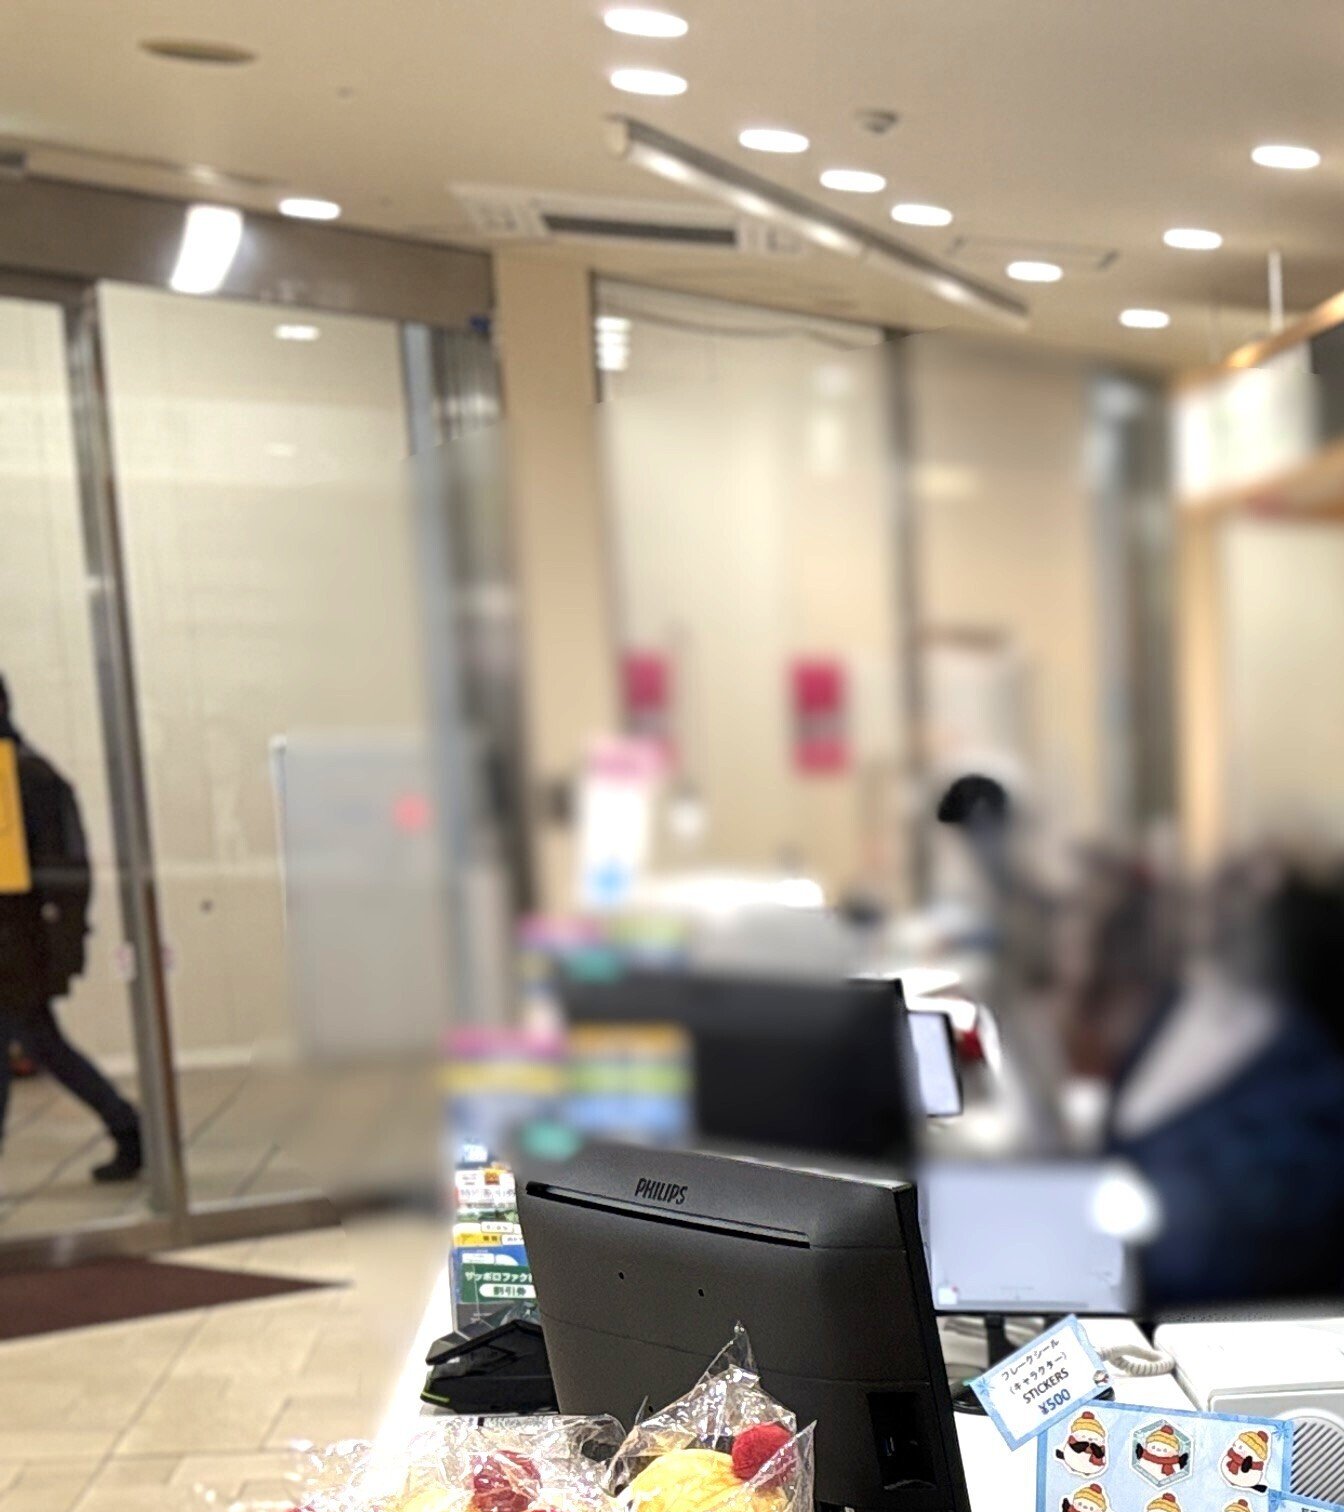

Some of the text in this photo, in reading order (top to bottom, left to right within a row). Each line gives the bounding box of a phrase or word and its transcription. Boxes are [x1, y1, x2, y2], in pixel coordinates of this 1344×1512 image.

[634, 1177, 689, 1205] PHILIPS
[1022, 1367, 1070, 1405] STICKERS
[1037, 1387, 1072, 1416] ¥500
